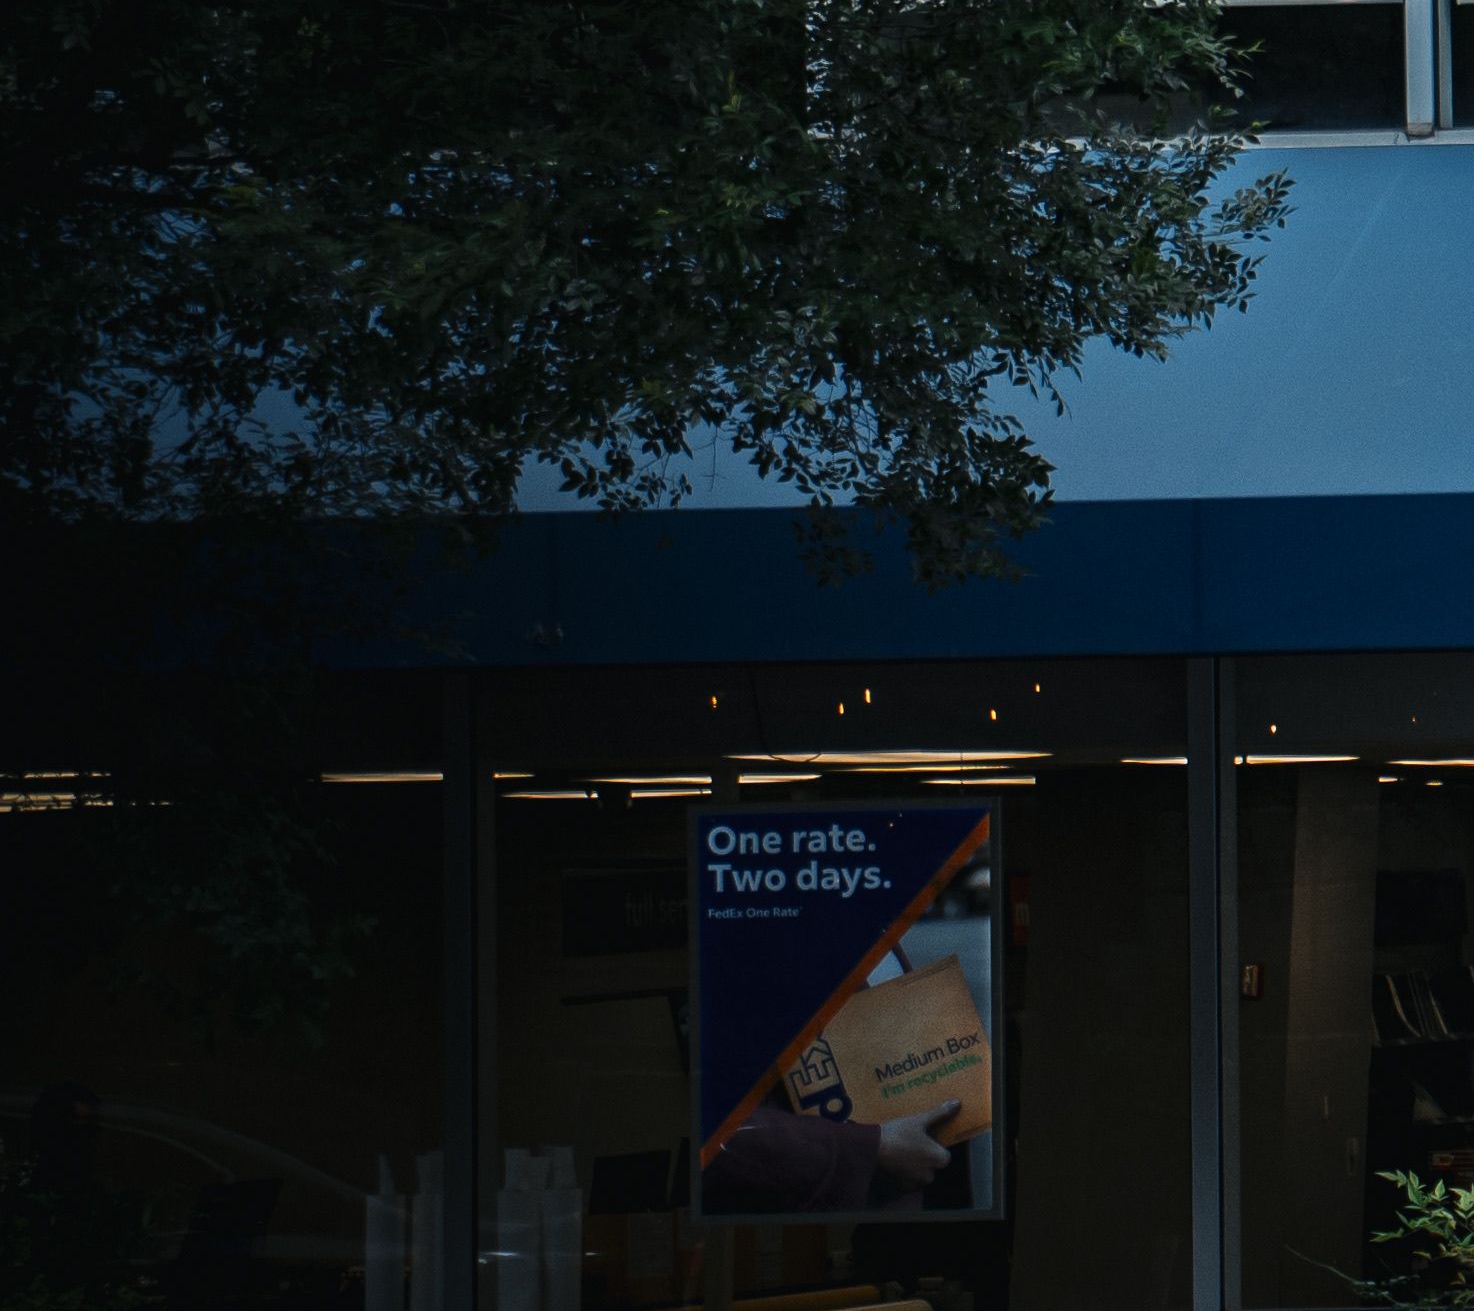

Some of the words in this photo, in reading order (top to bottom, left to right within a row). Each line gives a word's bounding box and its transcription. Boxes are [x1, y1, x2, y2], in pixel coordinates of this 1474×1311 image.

[707, 825, 783, 855] One
[792, 823, 877, 853] rate.
[707, 864, 787, 892] Two
[796, 860, 892, 898] days.
[708, 908, 743, 919] FedEx
[746, 908, 770, 918] One
[875, 1047, 945, 1082] Medium
[946, 1032, 980, 1055] Box
